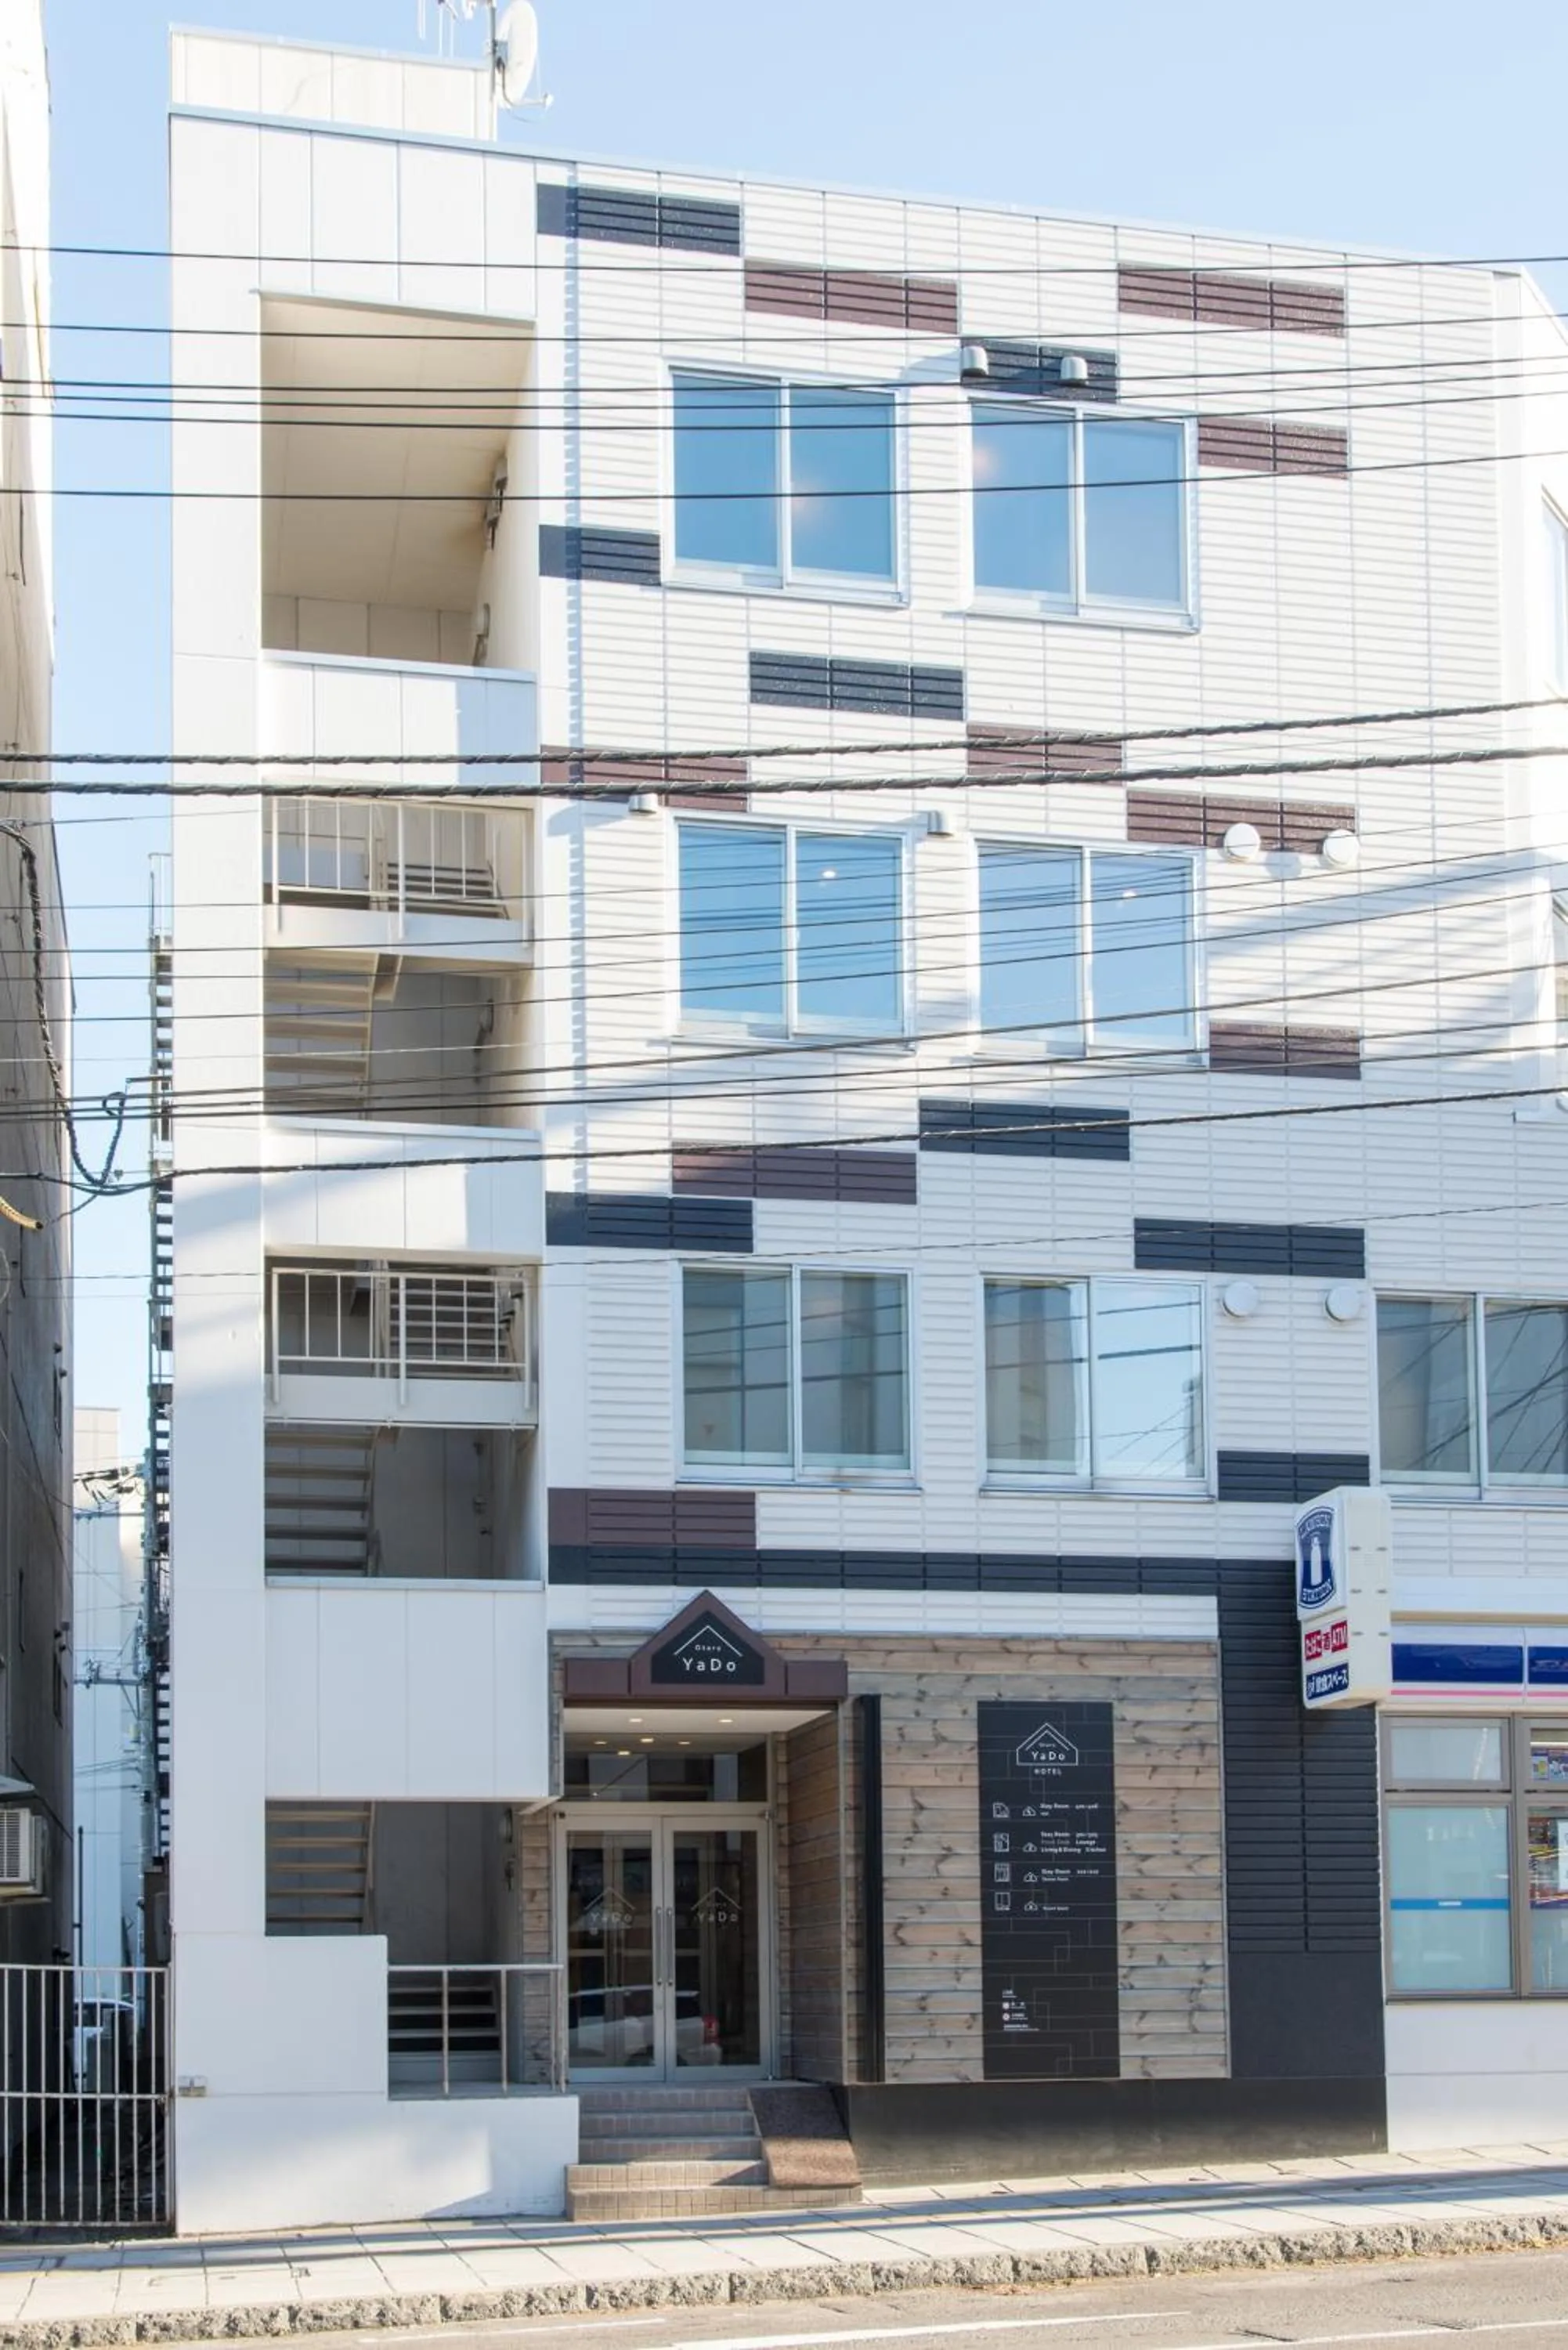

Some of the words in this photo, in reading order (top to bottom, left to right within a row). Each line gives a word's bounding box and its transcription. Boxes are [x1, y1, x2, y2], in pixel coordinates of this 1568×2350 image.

[1331, 1625, 1348, 1645] ATM
[682, 1657, 736, 1672] YaDo
[1031, 1751, 1066, 1761] YaDo
[1034, 1767, 1062, 1776] HOTEL
